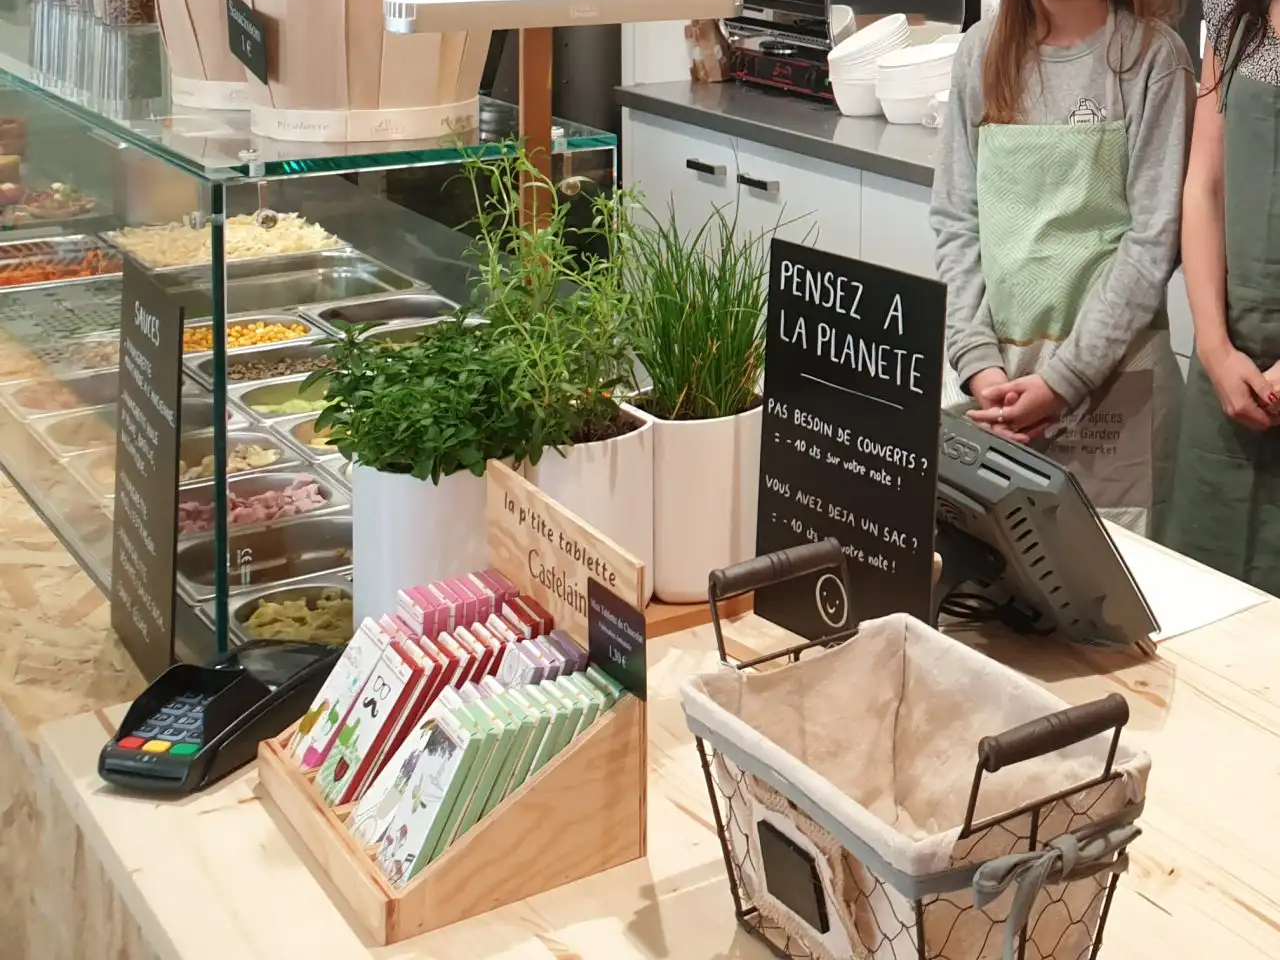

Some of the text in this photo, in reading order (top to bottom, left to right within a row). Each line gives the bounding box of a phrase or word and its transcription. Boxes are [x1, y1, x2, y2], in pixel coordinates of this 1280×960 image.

[134, 300, 161, 347] SAUCES
[780, 260, 904, 336] PENSEZ A
[780, 309, 925, 394] LA PLANETE
[768, 398, 788, 419] PAS
[836, 427, 852, 445] DE
[857, 436, 916, 469] COUVERTS
[920, 458, 928, 476] ?
[1080, 428, 1120, 440] Garden
[843, 459, 866, 476] votre
[869, 467, 892, 487] note
[896, 476, 902, 491] !
[504, 491, 516, 515] la
[558, 531, 617, 589] tablette
[765, 474, 919, 555] VOUS AVEZ DEJA UN SAC ?
[528, 548, 588, 618] Castelain
[868, 553, 889, 571] note
